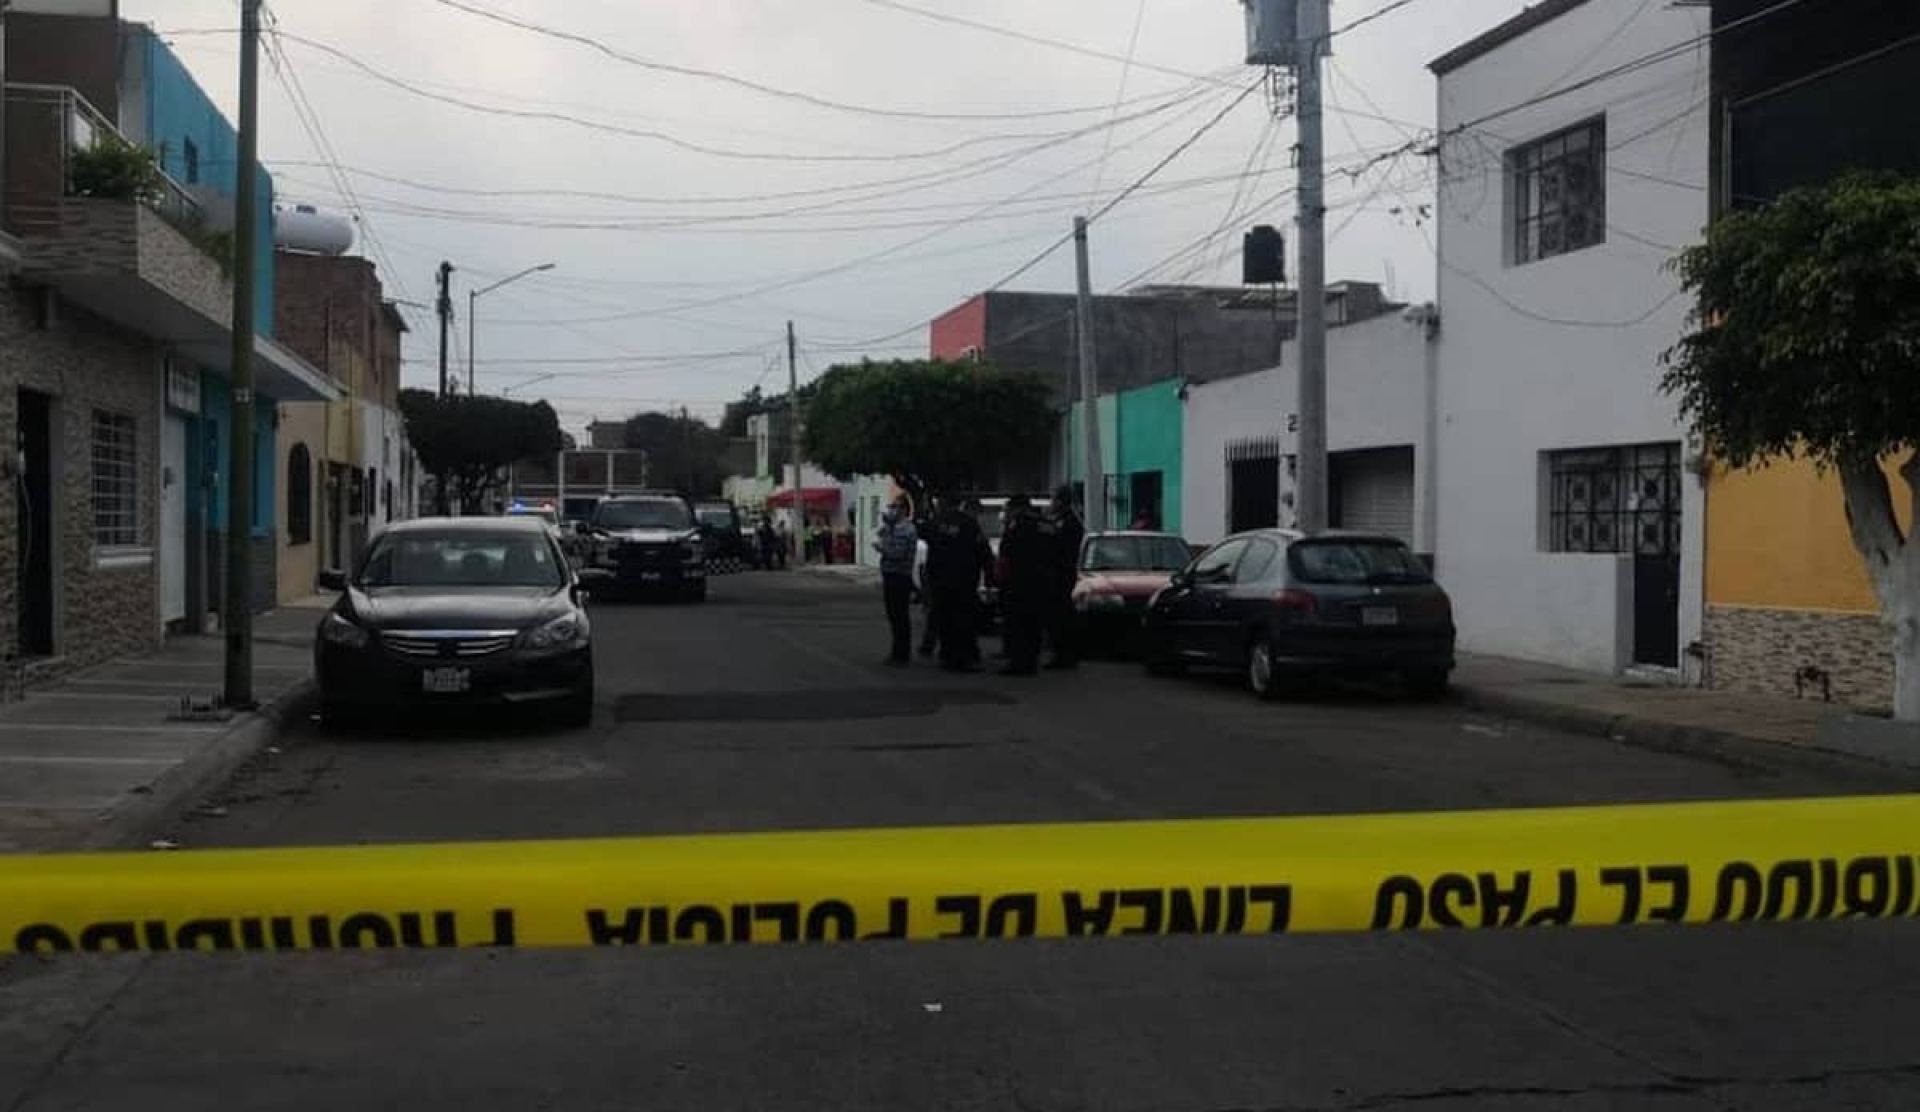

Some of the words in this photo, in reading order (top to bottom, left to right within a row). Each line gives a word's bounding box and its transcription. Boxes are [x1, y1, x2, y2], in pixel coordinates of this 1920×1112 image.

[1062, 885, 1291, 935] LINEA
[1370, 869, 1578, 931] PASO
[1600, 865, 1690, 924] EL
